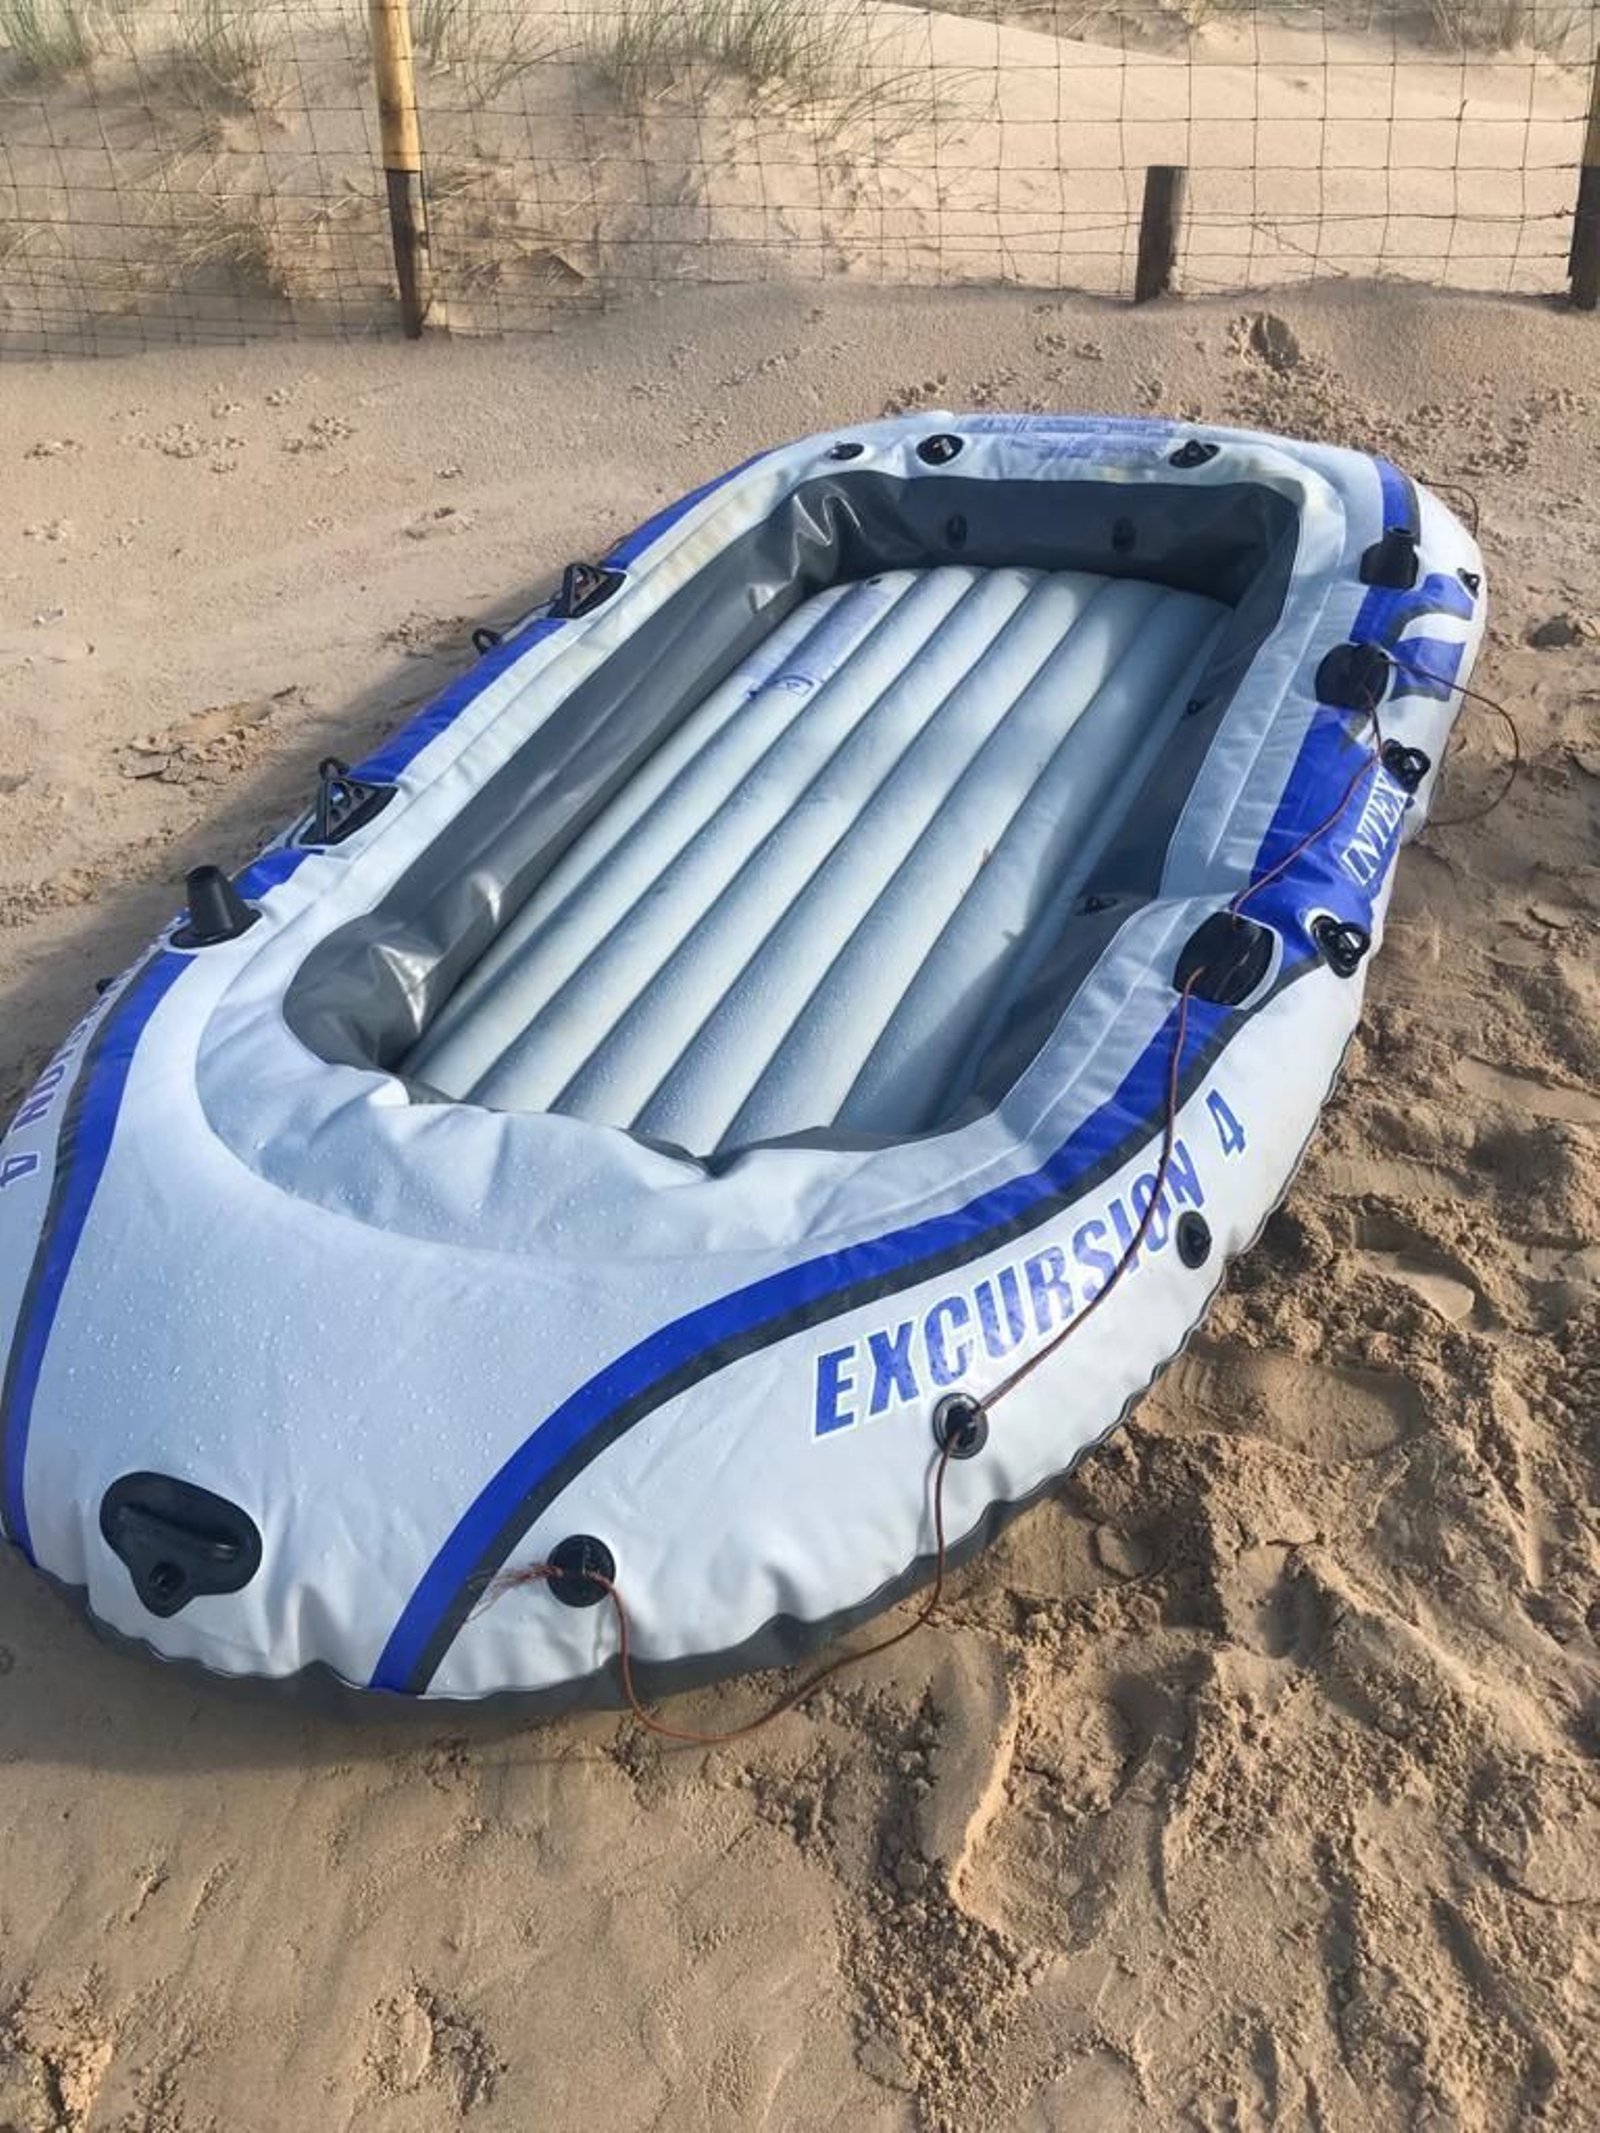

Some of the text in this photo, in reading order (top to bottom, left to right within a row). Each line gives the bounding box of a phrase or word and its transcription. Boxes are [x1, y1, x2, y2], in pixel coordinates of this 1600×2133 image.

[1341, 765, 1409, 887] INTEX
[812, 1088, 1248, 1439] EXCURSION 4
